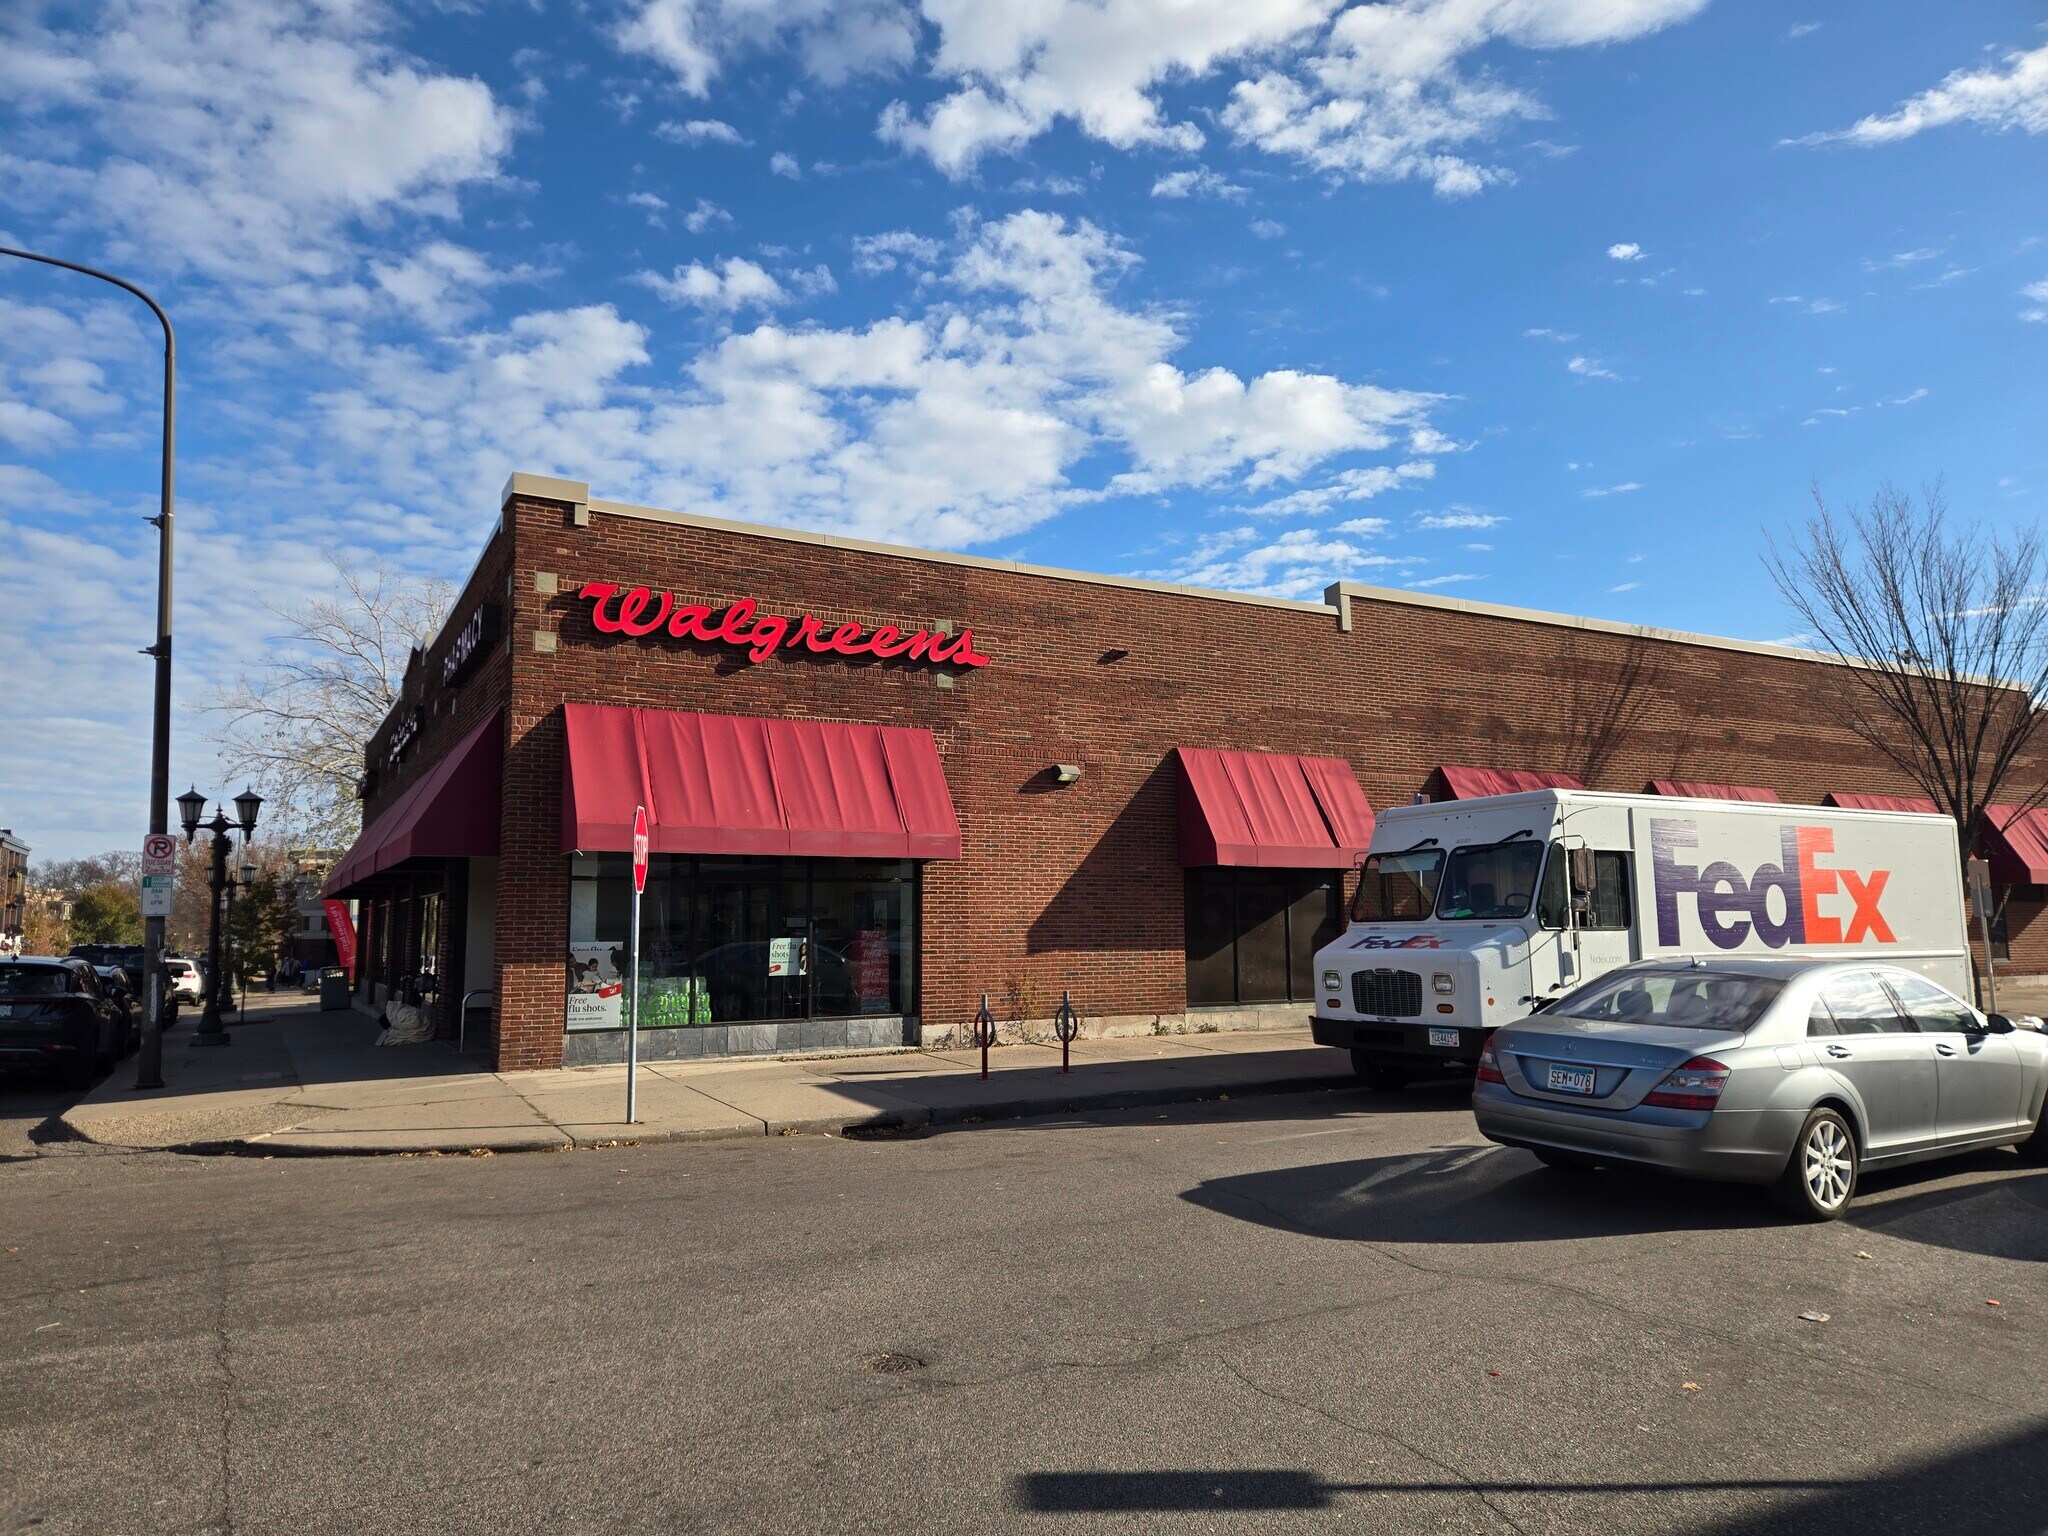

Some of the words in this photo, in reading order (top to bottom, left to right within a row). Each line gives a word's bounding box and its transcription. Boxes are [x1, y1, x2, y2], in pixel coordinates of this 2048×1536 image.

[578, 582, 991, 667] Walgreens
[634, 833, 647, 866] STOP
[1650, 817, 1898, 949] FedEx
[788, 942, 797, 950] flu
[1348, 936, 1452, 950] FedEx
[568, 1004, 581, 1013] flu
[582, 1004, 607, 1013] shots.
[569, 997, 587, 1005] Free
[1551, 1070, 1568, 1085] SEM
[1574, 1073, 1591, 1087] 078
